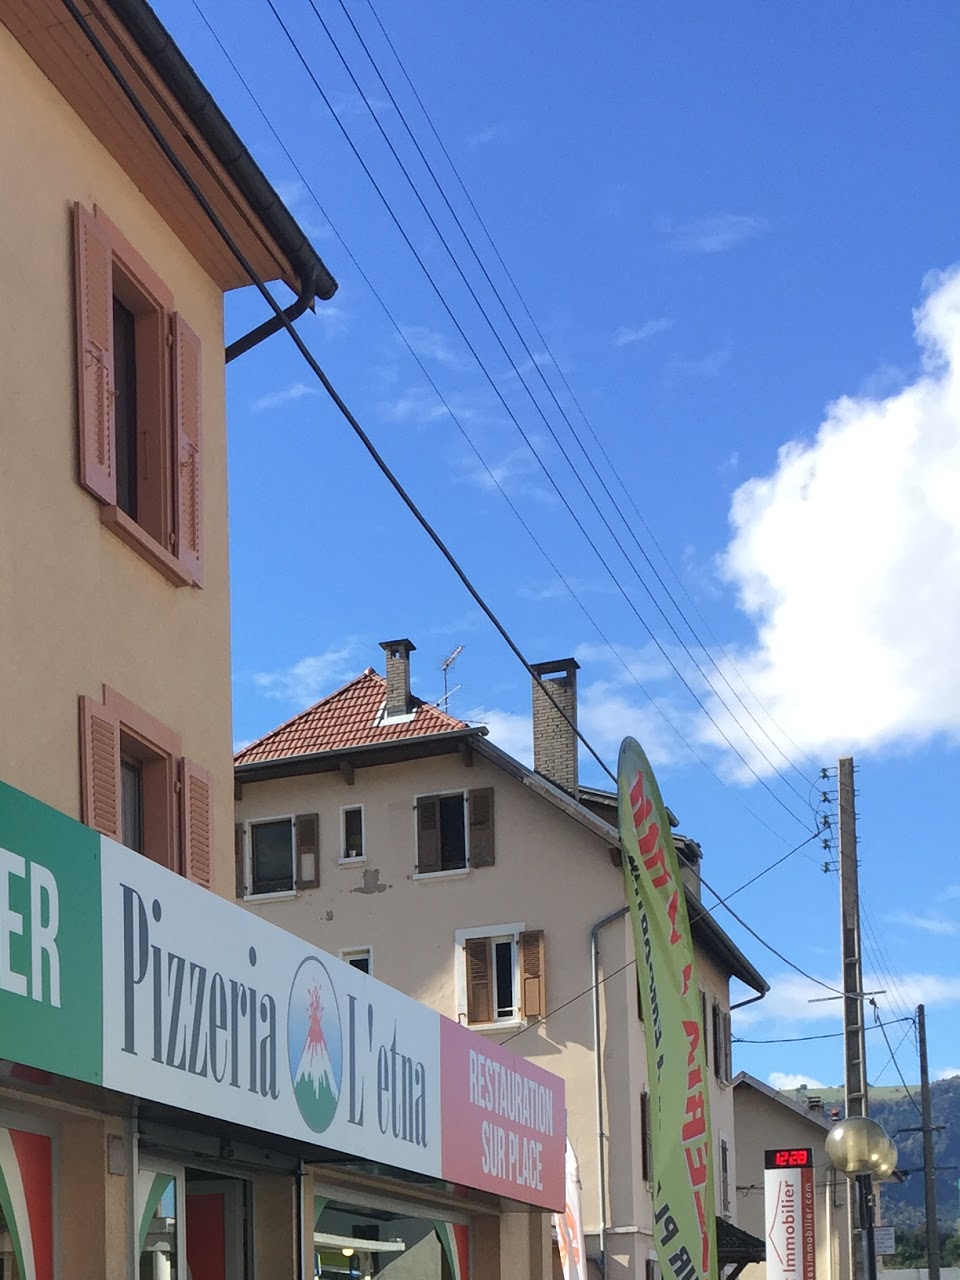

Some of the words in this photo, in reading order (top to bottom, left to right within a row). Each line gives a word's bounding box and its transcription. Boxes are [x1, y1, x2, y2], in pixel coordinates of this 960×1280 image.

[119, 882, 280, 1101] Pizzeria
[346, 993, 429, 1149] L'etna
[469, 1048, 554, 1137] RESTAURATION
[481, 1120, 506, 1180] SUR
[508, 1131, 544, 1191] PLACE
[781, 1180, 796, 1273] Immobilier
